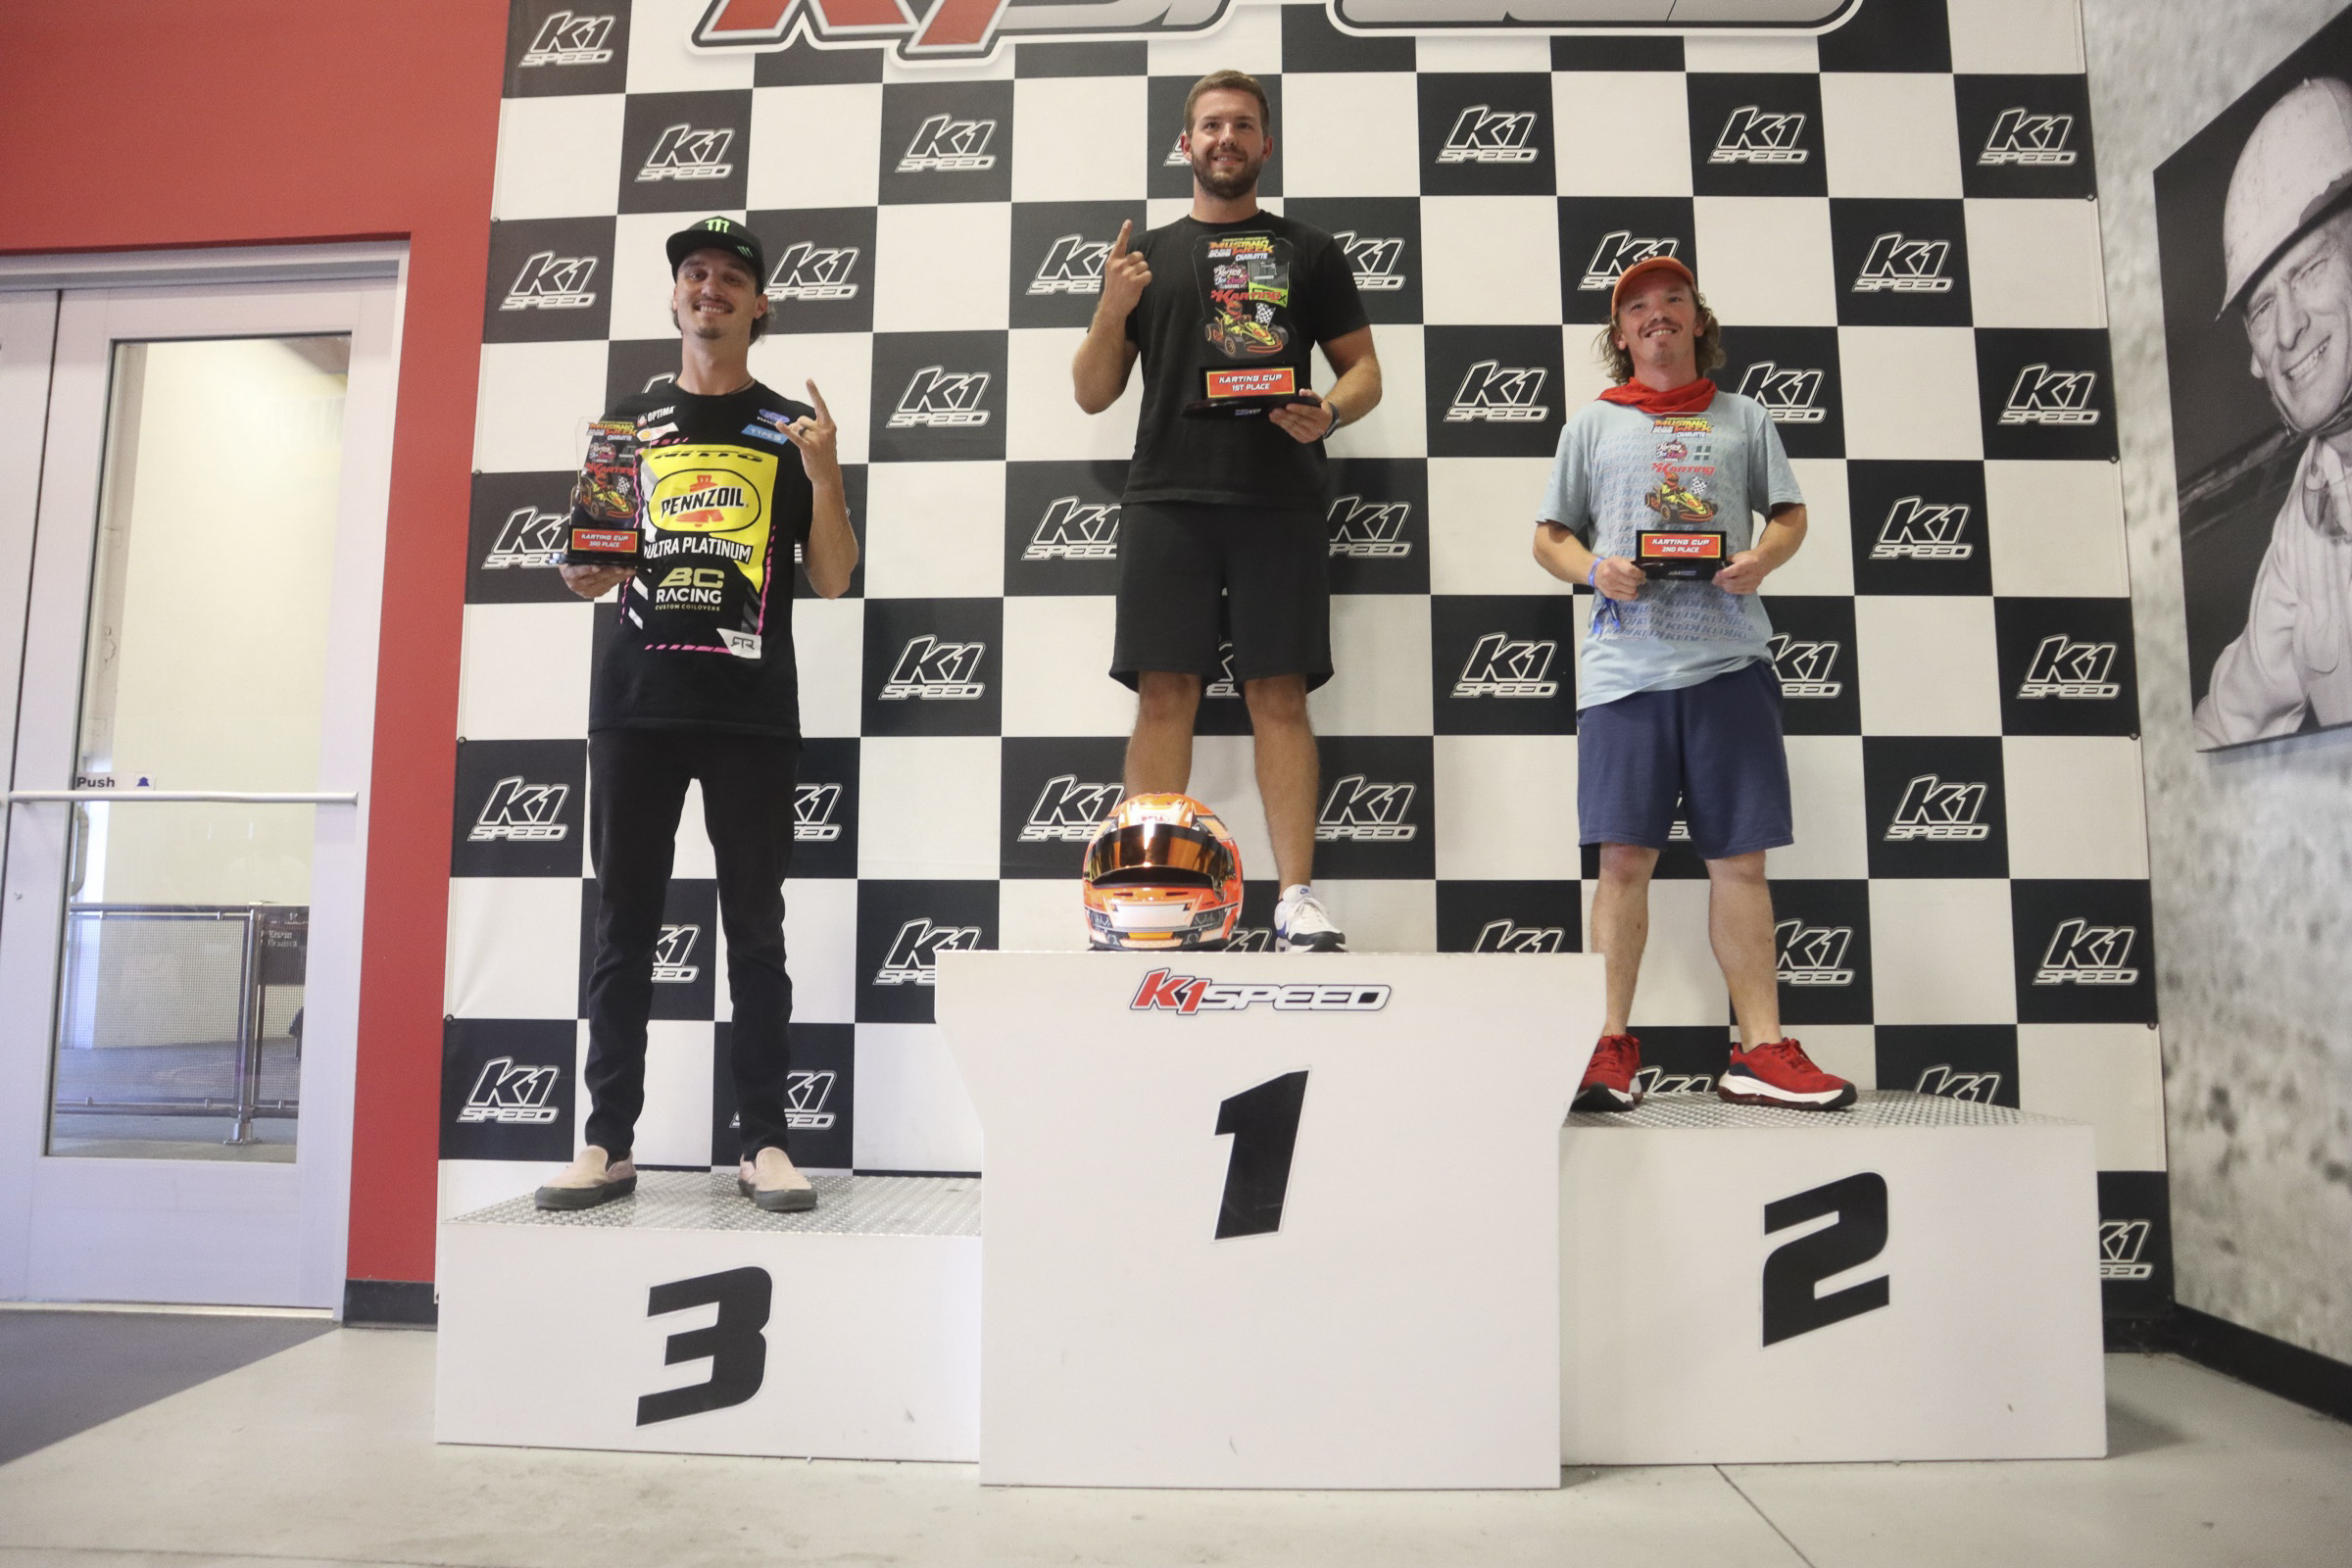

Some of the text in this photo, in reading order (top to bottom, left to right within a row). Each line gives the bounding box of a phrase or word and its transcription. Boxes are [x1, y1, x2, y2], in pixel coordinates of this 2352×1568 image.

[530, 12, 614, 52] K1
[520, 49, 612, 66] SPEED
[906, 115, 996, 158] K1
[1446, 106, 1535, 148] K1
[1718, 107, 1804, 149] K1
[1986, 109, 2072, 151] K1
[646, 124, 734, 167] K1
[1439, 147, 1537, 162] SPEED
[1710, 150, 1807, 163] SPEED
[897, 156, 995, 172] SPEED
[1980, 152, 2076, 165] SPEED
[637, 164, 733, 181] SPEED
[769, 242, 859, 286] K1
[1862, 234, 1948, 277] K1
[511, 252, 598, 295] K1
[1854, 278, 1952, 291] SPEED
[1028, 280, 1101, 294] SPEE
[501, 293, 596, 310] SPEED
[898, 368, 989, 413] K1
[1454, 362, 1545, 407] K1
[1737, 363, 1823, 407] K1
[2008, 365, 2095, 410] K1
[647, 406, 675, 421] OPTIMA
[889, 411, 989, 427] SPEED
[1446, 406, 1547, 420] SPEED
[1770, 409, 1826, 421] EED
[2000, 411, 2098, 423] SPEED
[662, 487, 745, 518] PENNZOIL
[1033, 498, 1121, 544] K1
[1327, 496, 1410, 541] K1
[1880, 498, 1969, 544] K1
[647, 537, 752, 564] ULTRA PLATINUM
[1329, 544, 1412, 557] PEED
[1872, 545, 1972, 558] SPEED
[659, 566, 724, 588] BC
[656, 588, 722, 605] RACING
[891, 637, 983, 683] K1
[1462, 634, 1555, 681] K1
[2027, 636, 2116, 683] K1
[881, 681, 983, 699] SPEED
[1453, 683, 1556, 696] SPEED
[1782, 683, 1842, 697] EED
[2019, 684, 2119, 698] SPEED
[76, 776, 115, 788] Push
[479, 777, 567, 825] K1
[1029, 777, 1125, 825] K1
[1319, 777, 1415, 824] K1
[1894, 776, 1985, 824] K1
[470, 824, 567, 841] SPEED
[1020, 826, 1102, 841] SPEE
[1314, 826, 1418, 840] SPEED
[1886, 825, 1988, 839] SPEED
[1776, 920, 1852, 968] K1
[2043, 920, 2134, 968] K1
[876, 969, 935, 984] SPE
[1778, 971, 1854, 984] PEED
[2035, 970, 2137, 983] SPEED
[468, 1058, 558, 1107] K1
[460, 1106, 557, 1122] SPEED
[1213, 1069, 1309, 1241] 1
[1762, 1171, 1889, 1348] 2
[635, 1265, 772, 1428] 3
